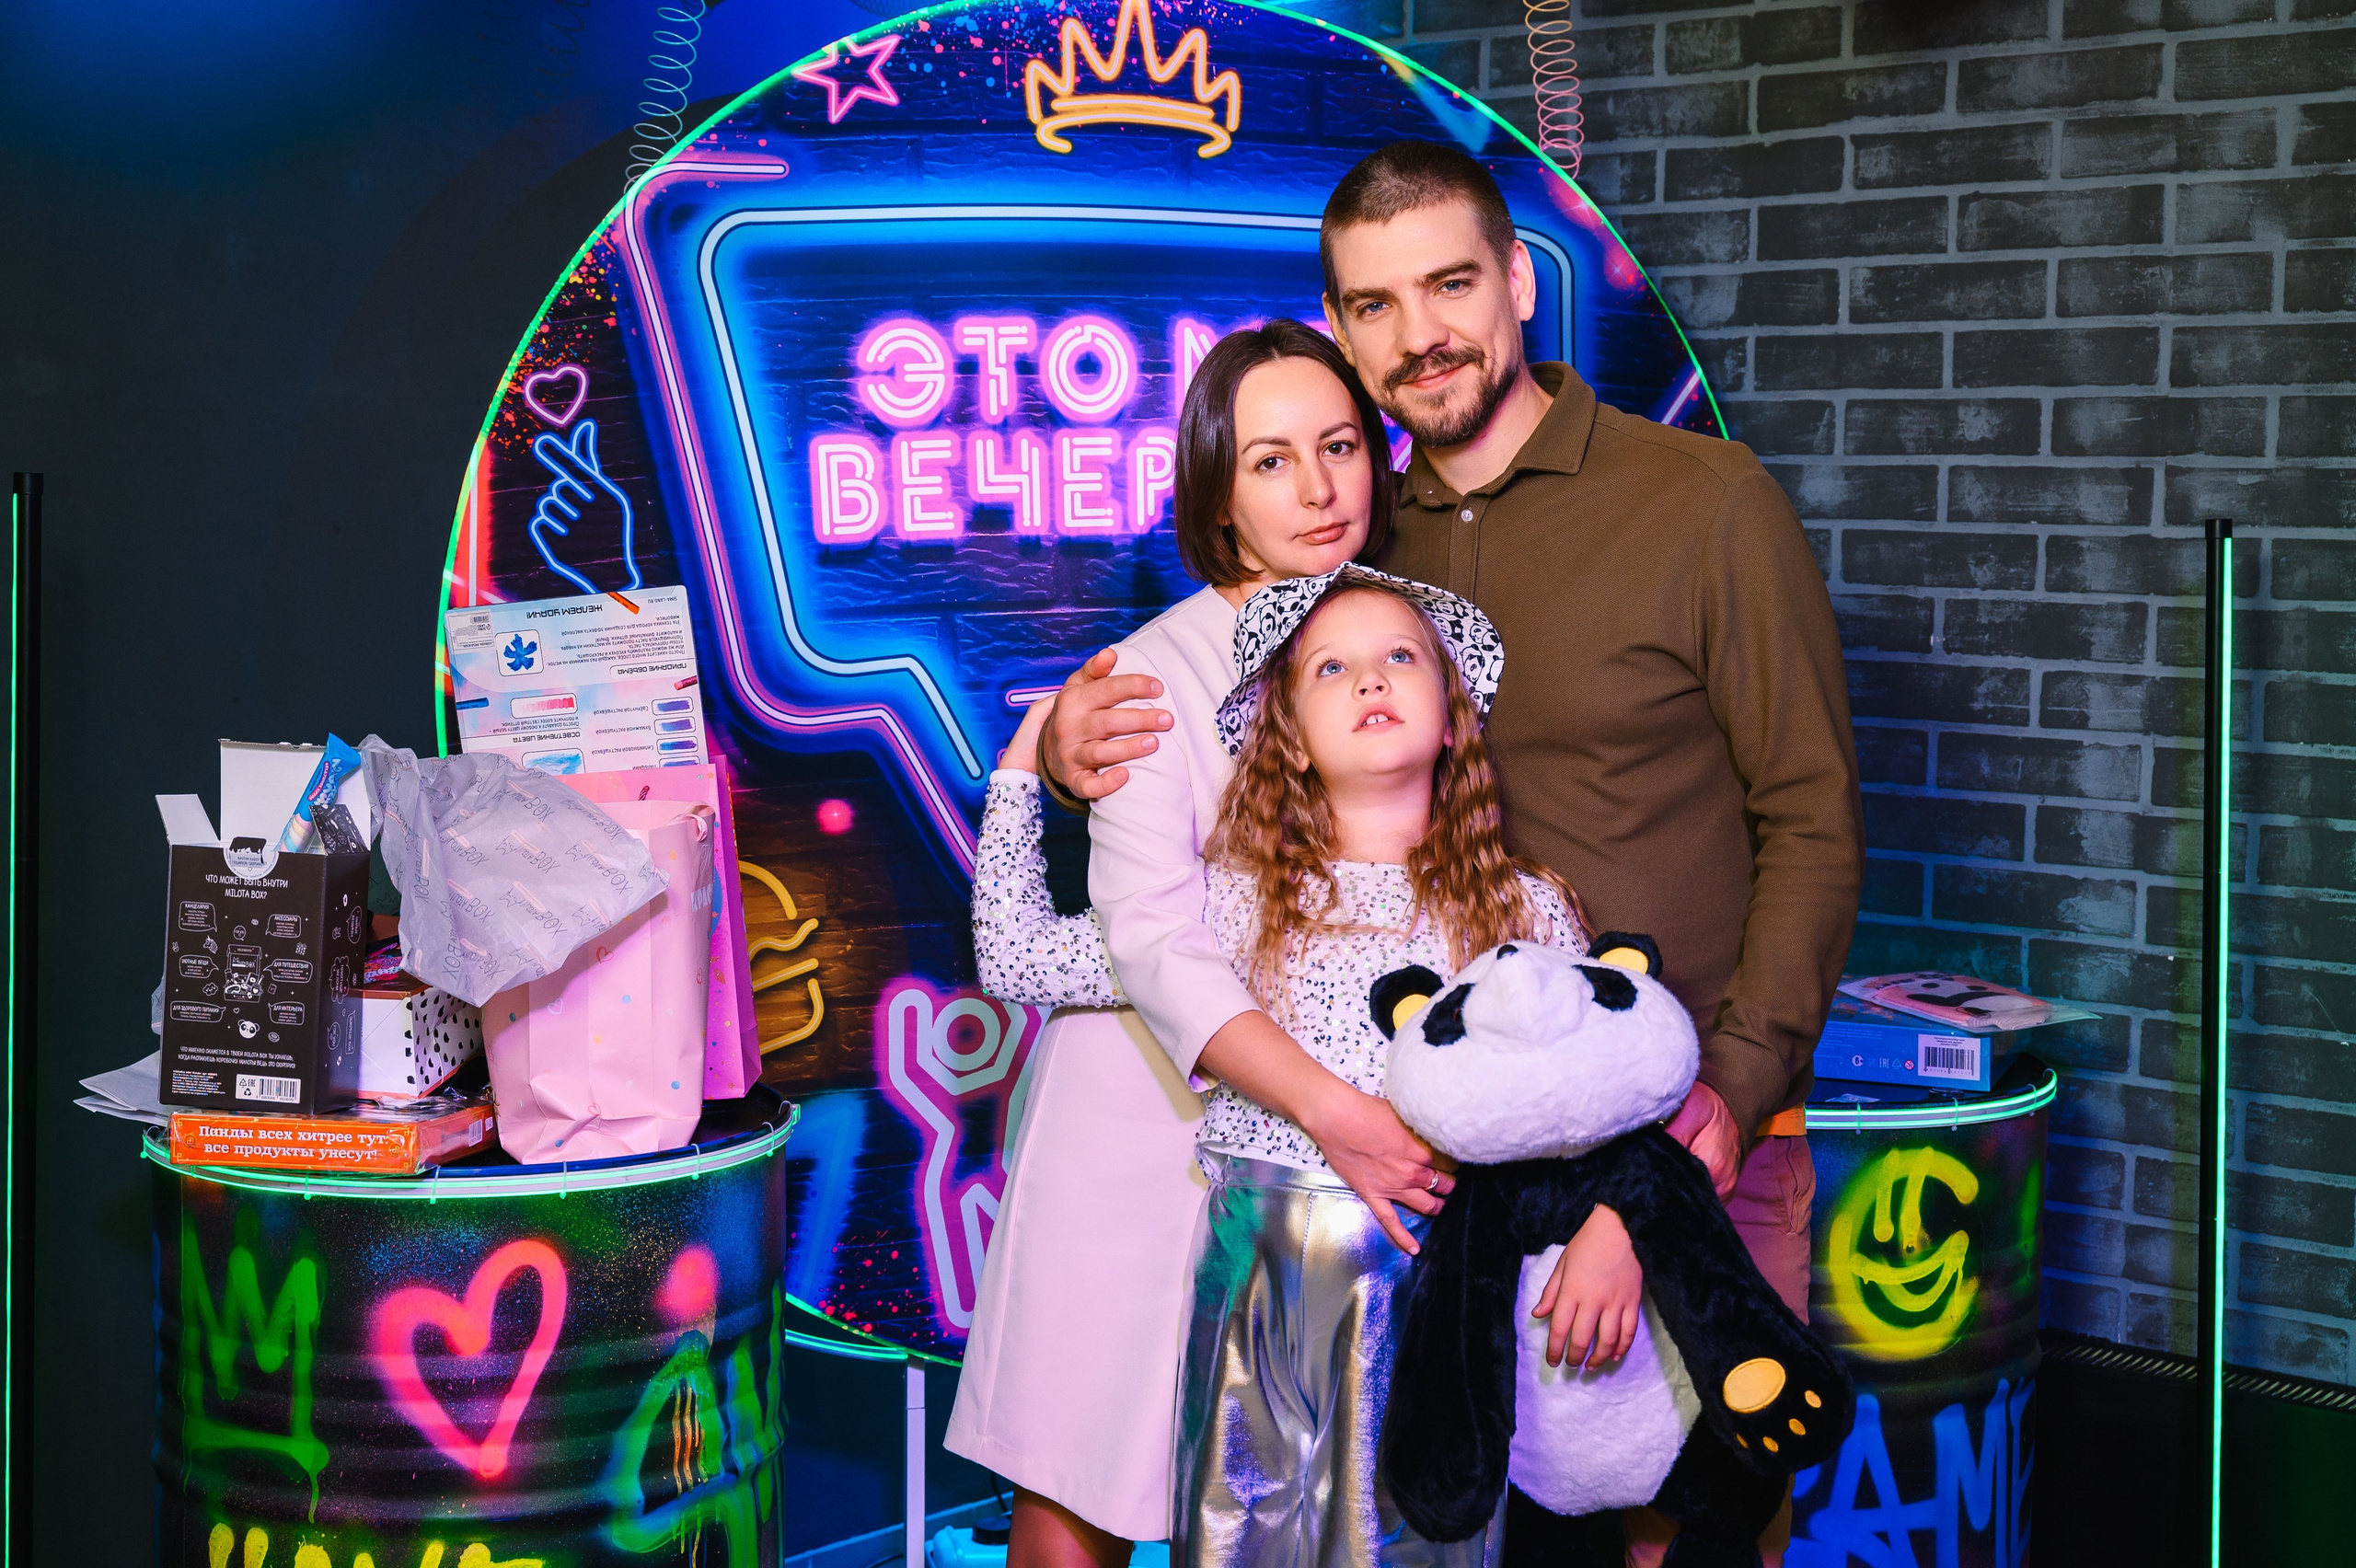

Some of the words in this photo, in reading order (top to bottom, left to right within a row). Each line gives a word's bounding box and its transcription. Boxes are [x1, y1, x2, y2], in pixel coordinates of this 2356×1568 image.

[864, 323, 1130, 421] ЭТО
[525, 608, 560, 618] УДАЧИ!
[561, 604, 603, 615] ЖЕЛАЕМ
[617, 666, 648, 674] ОБЪЁМА
[648, 663, 687, 672] ПРИДАНИЕ
[536, 731, 580, 741] ОСВЕТЛЕНИЕ
[204, 873, 218, 883] ЧТО
[218, 874, 242, 885] МОЖЕТ
[243, 878, 262, 887] БЫТЬ
[261, 878, 289, 888] ВНУТРИ
[224, 887, 250, 898] MILOTA
[250, 889, 268, 899] BOX?
[198, 1125, 254, 1139] Панды
[258, 1129, 293, 1140] всех
[296, 1131, 352, 1144] хитрее
[203, 1143, 229, 1153] все
[233, 1144, 314, 1159] продукты
[318, 1147, 377, 1161] унесут!
